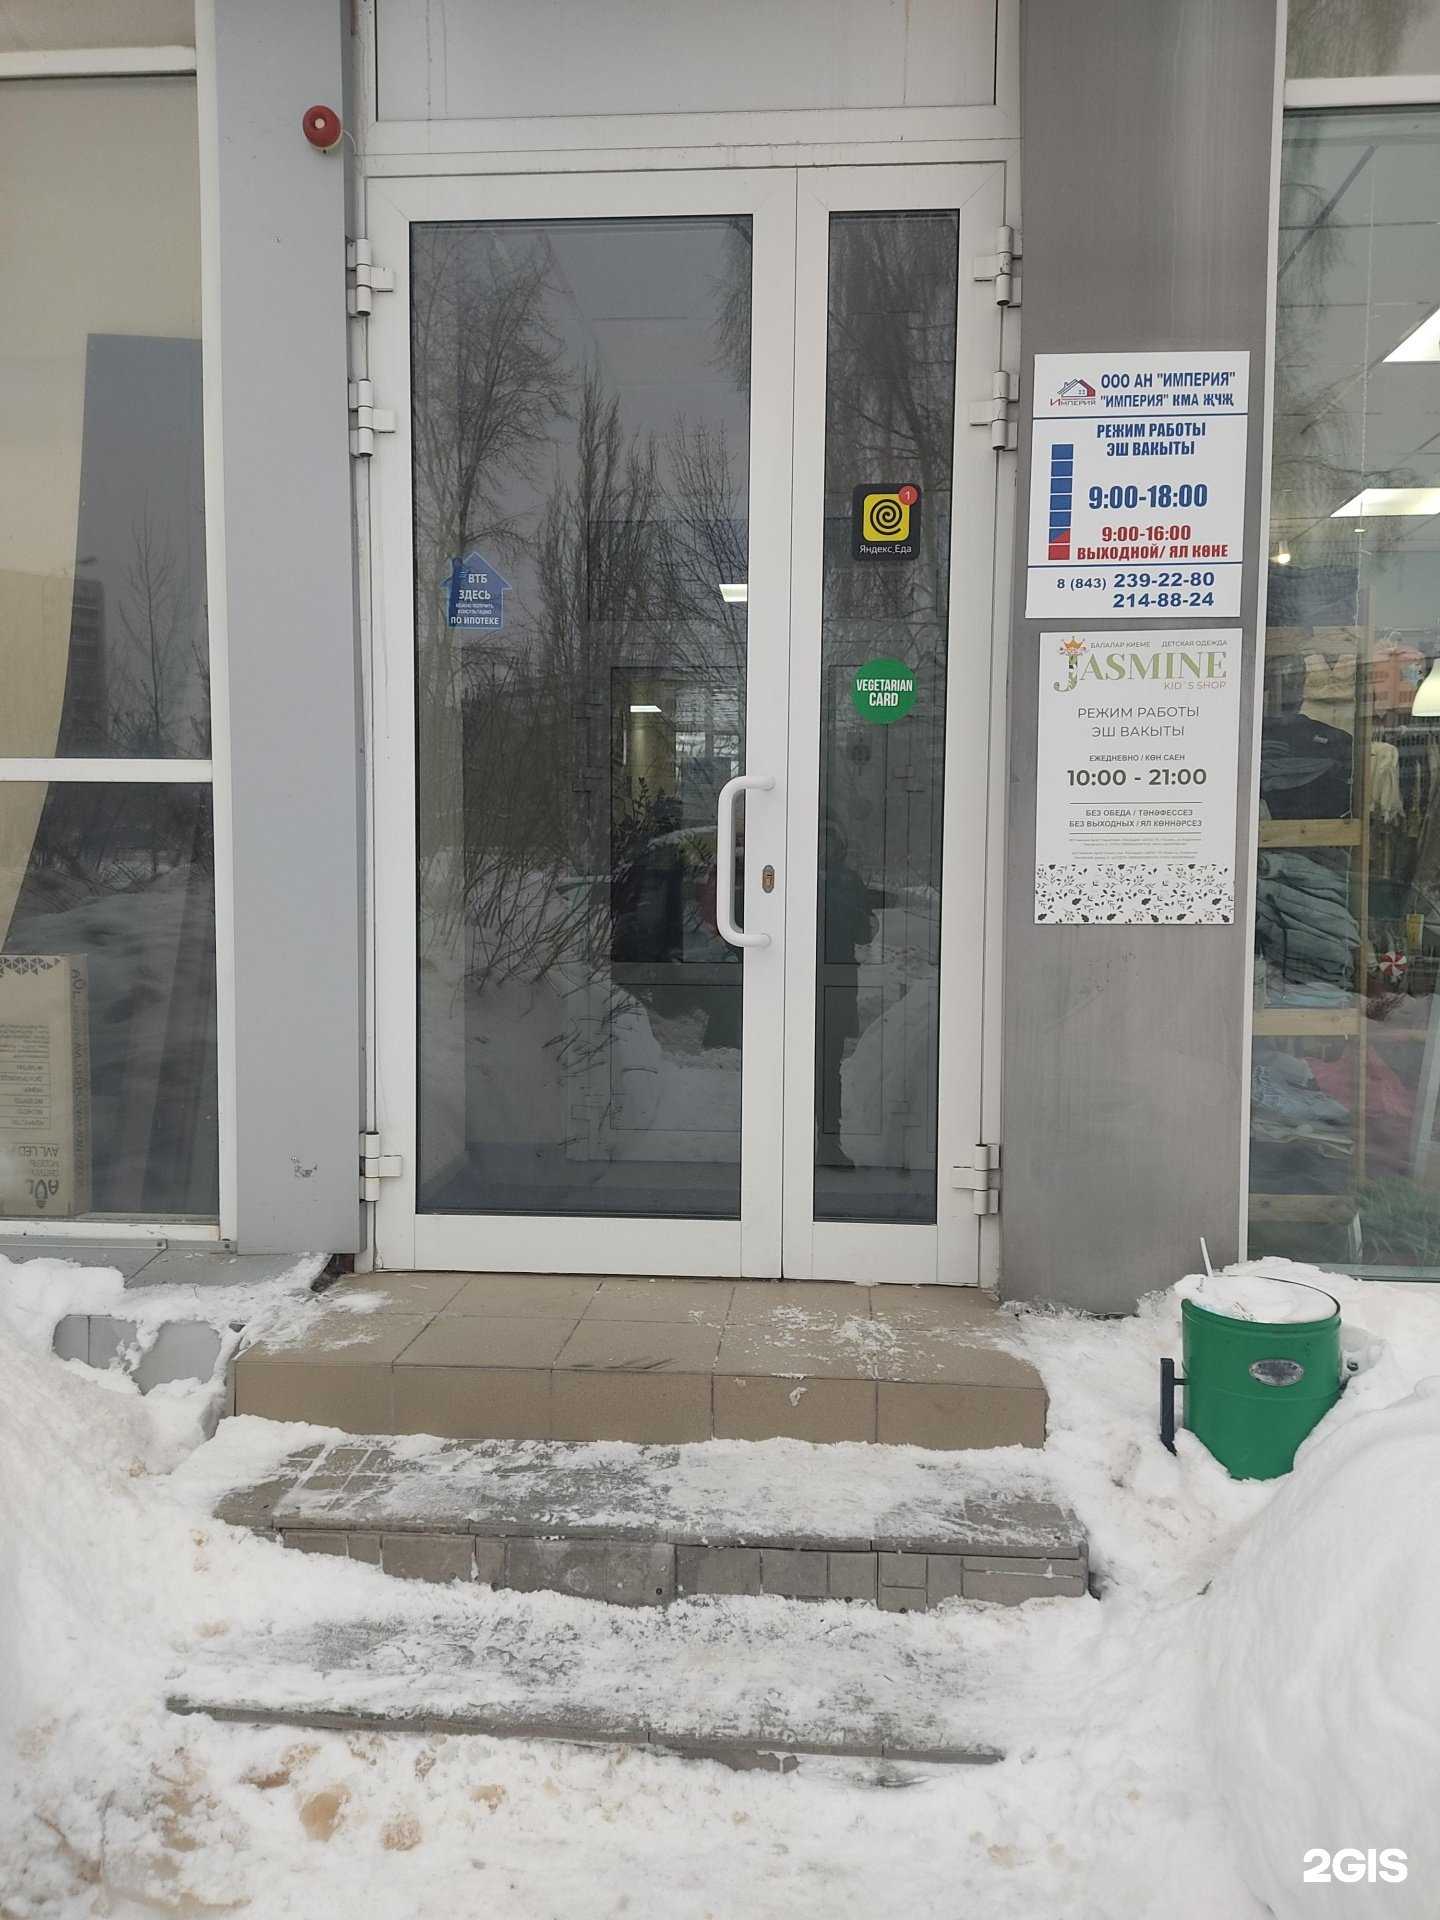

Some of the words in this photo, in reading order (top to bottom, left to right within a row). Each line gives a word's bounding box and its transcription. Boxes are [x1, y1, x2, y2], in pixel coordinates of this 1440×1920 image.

[1101, 374, 1130, 389] ООО
[1134, 373, 1153, 388] АН
[1157, 372, 1236, 387] "ИМПЕРИЯ"
[1100, 394, 1168, 408] "ИМПЕРИЯ"
[1172, 393, 1199, 406] КМА
[1096, 424, 1146, 438] РЕЖИМ
[1149, 422, 1206, 437] РАБОТЫ
[1106, 443, 1129, 457] ЭШ
[1132, 441, 1195, 456] ВАКЫТЫ
[1088, 484, 1208, 509] 9:00-18:00
[1101, 525, 1191, 542] 9:00-16:00
[1077, 544, 1166, 562] ВЫХОДНОЙ/
[1169, 546, 1188, 558] ЯЛ
[1192, 544, 1228, 558] КӨНЕ
[468, 574, 488, 584] ВТБ
[1056, 578, 1065, 589] 8
[1070, 577, 1107, 591] (843)
[1113, 572, 1215, 588] 239-22-80
[458, 590, 491, 601] ЗДЕСЬ
[1112, 592, 1214, 608] 214-88-24
[450, 616, 462, 624] ПО
[463, 616, 500, 625] ИПОТЕКЕ
[1161, 640, 1194, 648] ДЕТСКАЯ
[1195, 639, 1228, 648] ОДЕЖДА
[1053, 651, 1228, 692] JASMINE
[856, 679, 913, 692] VEGETARIAN
[1197, 681, 1227, 689] SHOP
[869, 692, 899, 706] CARD
[1077, 707, 1133, 719] РЕЖИМ
[1137, 706, 1200, 718] РАБОТЫ
[1091, 726, 1116, 737] ЭШ
[1120, 725, 1185, 737] ВАКЫТЫ
[1067, 769, 1127, 786] 10:00
[1148, 768, 1207, 786] 21:00
[1085, 809, 1101, 817] БЕЗ
[1103, 809, 1131, 817] ОБЕДА
[1069, 820, 1085, 828] БЕЗ
[1087, 819, 1135, 828] ВЫХОДНЫХ
[1140, 819, 1152, 827] ЯЛ
